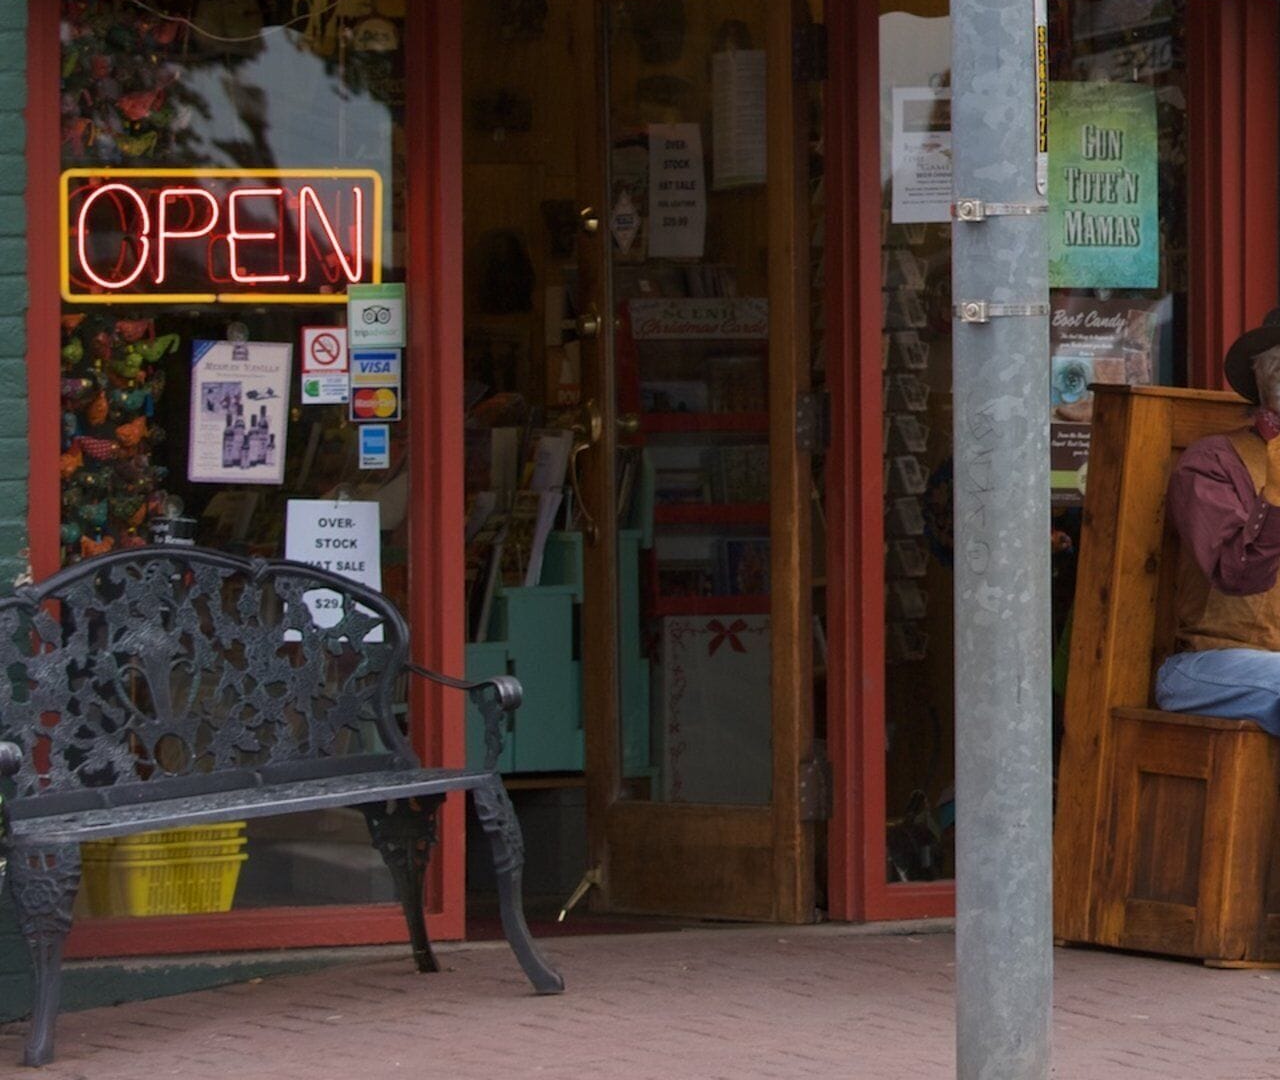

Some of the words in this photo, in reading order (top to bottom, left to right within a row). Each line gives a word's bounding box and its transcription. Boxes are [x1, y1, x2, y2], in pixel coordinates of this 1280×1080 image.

[1082, 125, 1123, 162] GUN
[77, 182, 363, 289] OPEN
[1064, 210, 1139, 247] MAMAS
[1084, 310, 1127, 333] Candy
[360, 362, 391, 373] VISA
[318, 518, 356, 528] OVER-
[315, 538, 358, 549] STOCK
[336, 561, 366, 571] SALE
